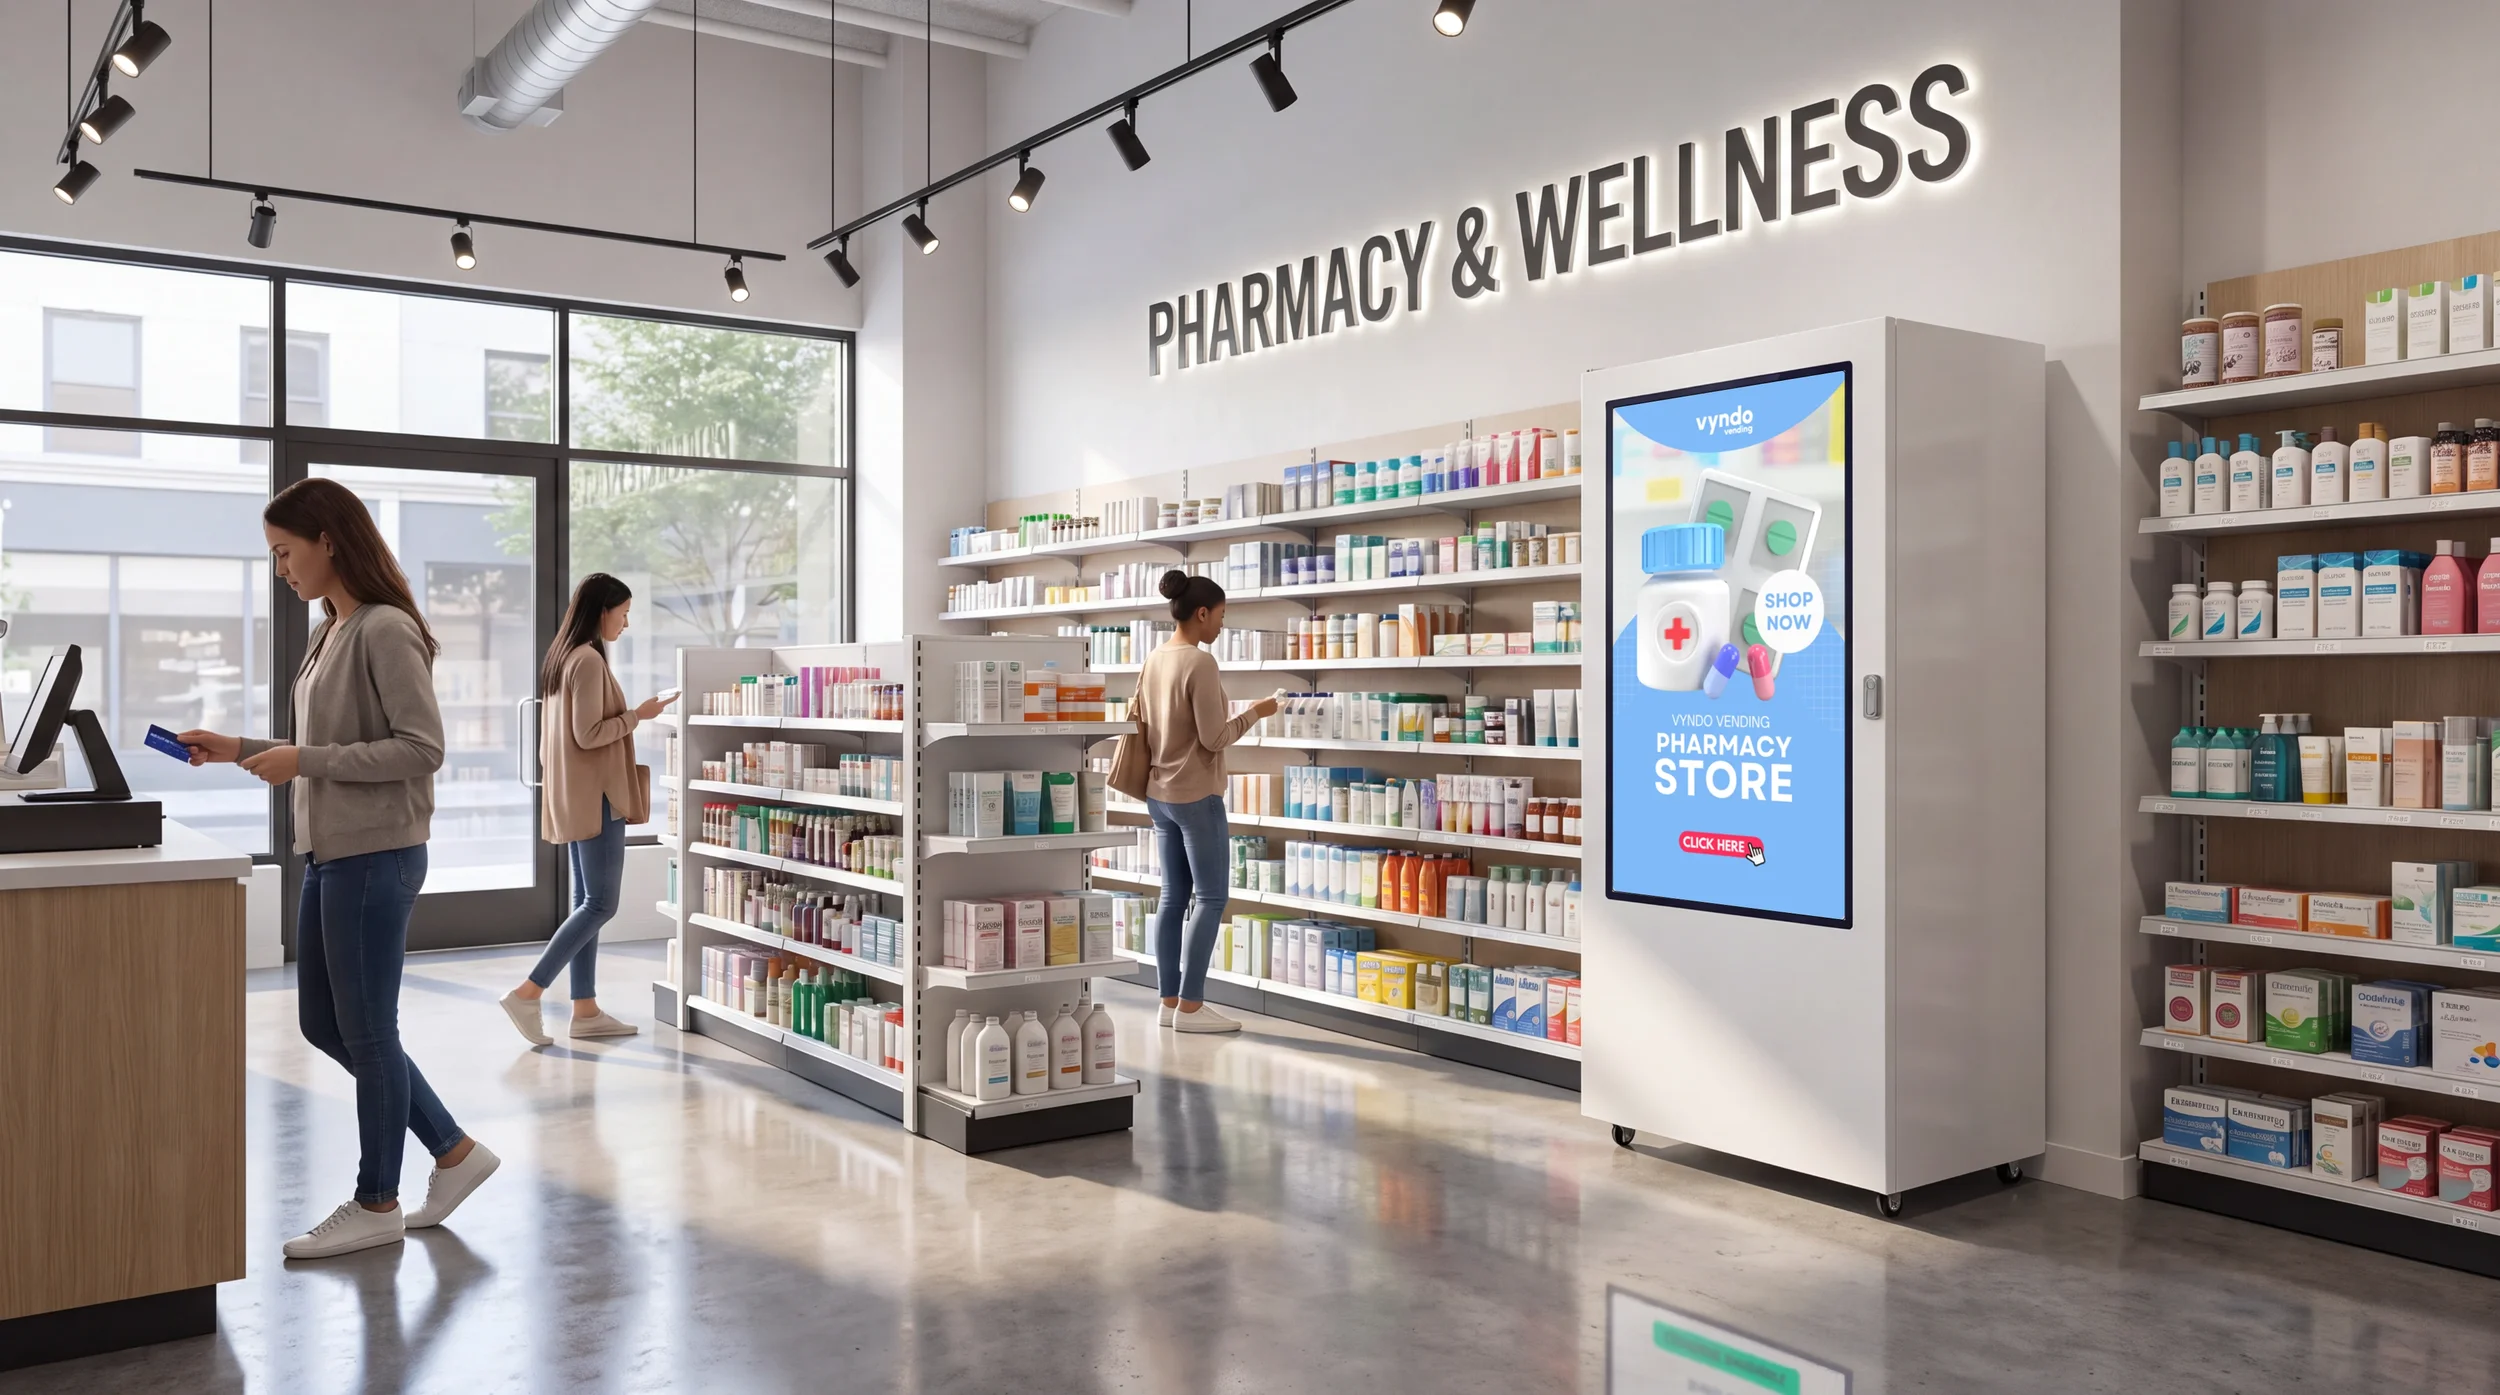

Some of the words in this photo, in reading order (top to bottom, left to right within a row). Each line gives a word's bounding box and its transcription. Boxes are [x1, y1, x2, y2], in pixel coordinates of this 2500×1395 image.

[1148, 219, 1437, 377] PHARMACY
[1450, 206, 1500, 301] &
[1515, 63, 1970, 283] WELLNESS
[1695, 405, 1754, 435] vyndo
[1724, 425, 1754, 435] vending
[1765, 591, 1814, 608] SHOP
[1767, 614, 1812, 631] NOW
[1671, 714, 1713, 727] VYNDO
[1716, 715, 1770, 728] VENDING
[1656, 732, 1792, 758] PHARMACY
[1655, 757, 1793, 803] STORE
[1683, 836, 1714, 850] CLICK
[1717, 838, 1745, 853] HERE
